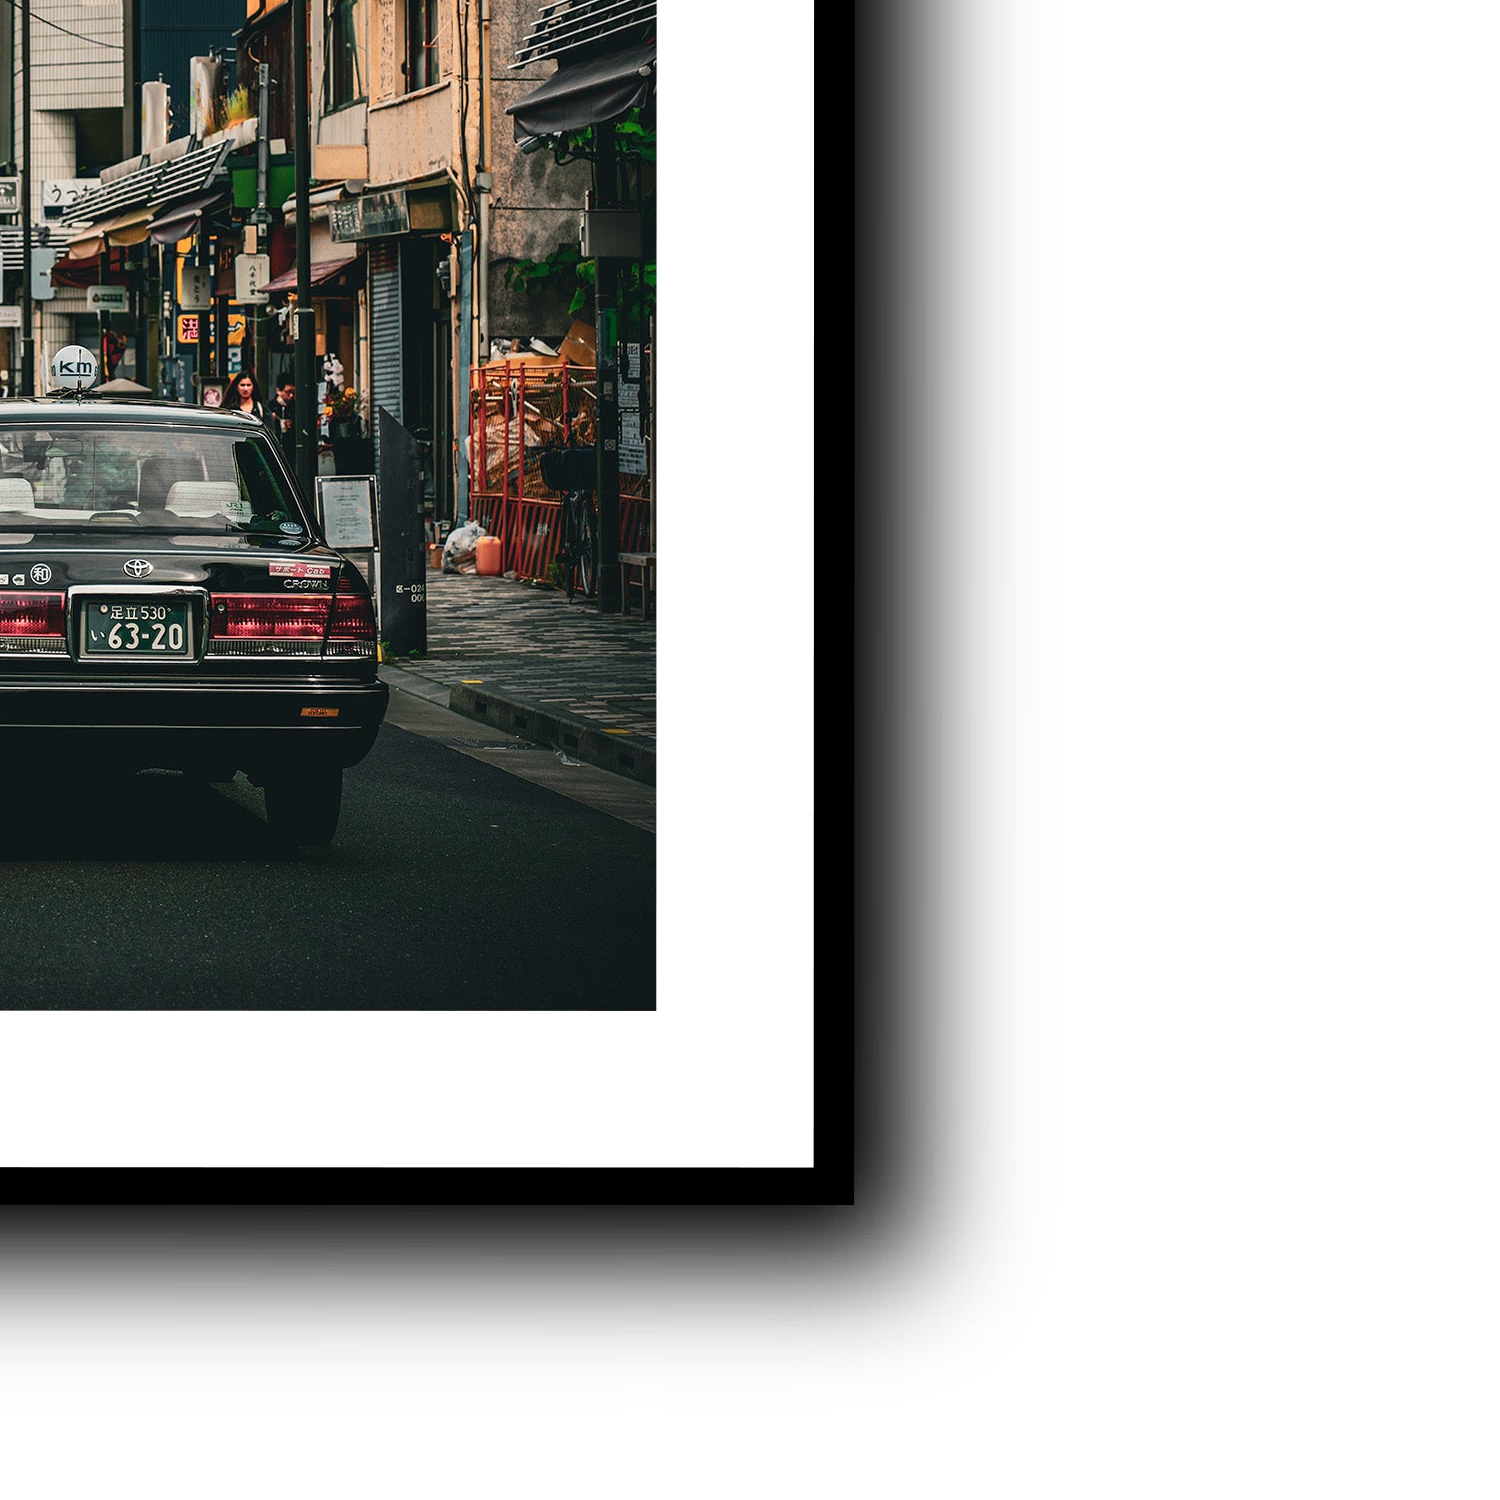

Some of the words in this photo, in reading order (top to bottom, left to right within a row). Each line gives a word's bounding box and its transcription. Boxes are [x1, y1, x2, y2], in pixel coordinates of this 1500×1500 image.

[32, 565, 50, 582] 和
[275, 565, 304, 574] サポート
[306, 566, 325, 575] Cab
[283, 579, 329, 590] CROWN
[107, 622, 183, 650] 63-20
